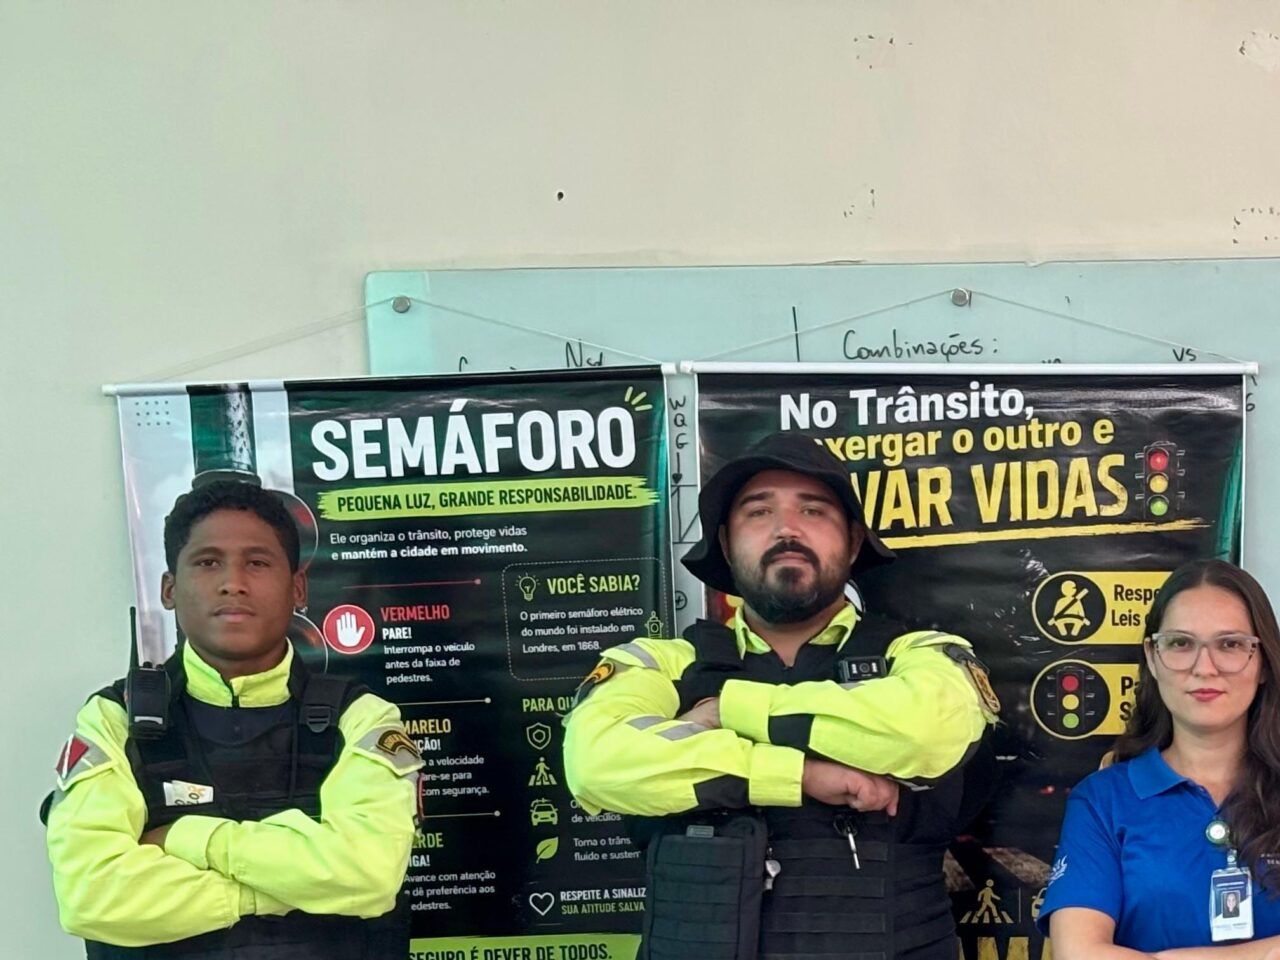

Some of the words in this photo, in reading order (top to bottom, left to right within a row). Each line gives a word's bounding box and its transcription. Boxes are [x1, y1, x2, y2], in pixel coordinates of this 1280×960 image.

[780, 393, 837, 431] No
[849, 381, 1034, 425] Trânsito,
[311, 398, 636, 481] SEMÁFORO
[816, 425, 942, 467] xergar
[952, 428, 974, 453] o
[983, 418, 1082, 452] outro
[1093, 418, 1115, 445] e
[338, 493, 401, 512] PEQUENA
[405, 492, 435, 511] LUZ,
[439, 490, 494, 508] GRANDE
[499, 484, 637, 506] RESPONSABILIDADE.
[850, 465, 954, 530] VAR
[970, 454, 1129, 524] VIDAS
[330, 533, 346, 544] Ele
[349, 531, 395, 546] organiza
[398, 533, 405, 541] o
[408, 528, 452, 542] trânsito,
[454, 527, 496, 542] protege
[499, 526, 527, 537] vidas
[331, 551, 338, 560] e
[341, 547, 388, 561] mantém
[390, 549, 397, 558] a
[400, 545, 437, 558] cidade
[441, 547, 458, 556] em
[461, 541, 527, 556] movimento.
[547, 573, 585, 595] VOCÊ
[589, 574, 640, 593] SABIA?
[380, 604, 450, 622] VERMELHO
[520, 612, 528, 621] O
[530, 609, 567, 621] primeiro
[568, 607, 609, 619] semáforo
[1111, 609, 1141, 626] Leis
[382, 627, 412, 640] PARE!
[521, 627, 533, 637] do
[535, 625, 565, 637] mundo
[566, 625, 578, 635] foi
[580, 623, 619, 635] instalado
[621, 624, 635, 633] em
[384, 644, 433, 656] Interrompa
[562, 643, 576, 652] em
[385, 660, 409, 670] antes
[412, 659, 423, 669] da
[425, 657, 447, 668] faixa
[449, 657, 461, 667] de
[386, 673, 433, 686] pedestres.
[522, 698, 554, 712] PARA
[401, 718, 451, 734] MARELO
[436, 754, 484, 766] velocidade
[452, 772, 472, 782] para
[571, 814, 583, 823] de
[600, 838, 606, 846] o
[438, 873, 458, 881] com
[460, 869, 496, 882] atenção
[426, 885, 477, 898] preferência
[560, 889, 601, 902] RESPEITE
[603, 888, 610, 899] A
[612, 887, 647, 899] SINALIZ
[561, 904, 579, 915] SUA
[581, 902, 616, 914] ATITUDE
[618, 901, 646, 912] SALVA
[559, 943, 612, 960] TODOS.
